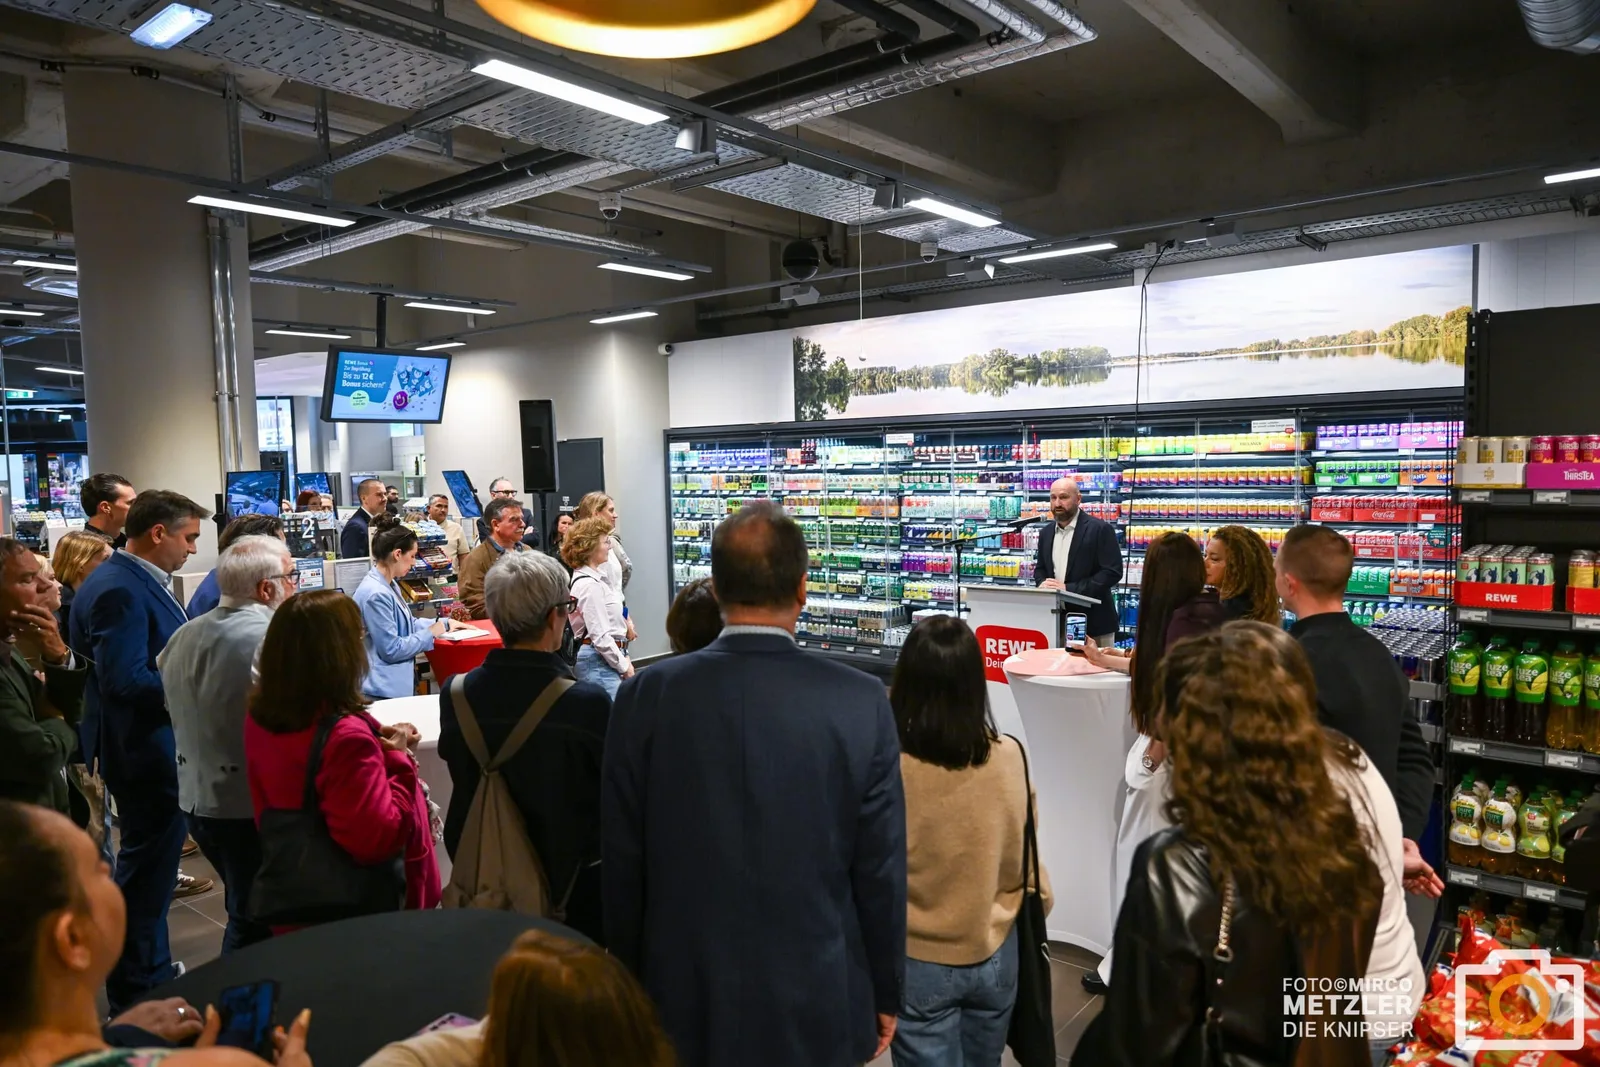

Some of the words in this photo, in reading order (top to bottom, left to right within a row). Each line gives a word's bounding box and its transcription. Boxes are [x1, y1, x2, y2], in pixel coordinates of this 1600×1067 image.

[343, 371, 352, 379] Bis
[341, 379, 361, 387] Bonus
[1563, 470, 1595, 480] THIRSTEA
[302, 518, 314, 539] 2
[1485, 593, 1518, 603] REWE
[985, 637, 1036, 656] REWE
[1450, 658, 1472, 670] fuze
[1485, 660, 1508, 671] fuze
[1486, 669, 1502, 677] tea
[1516, 665, 1539, 677] fuze
[1516, 673, 1532, 682] tea
